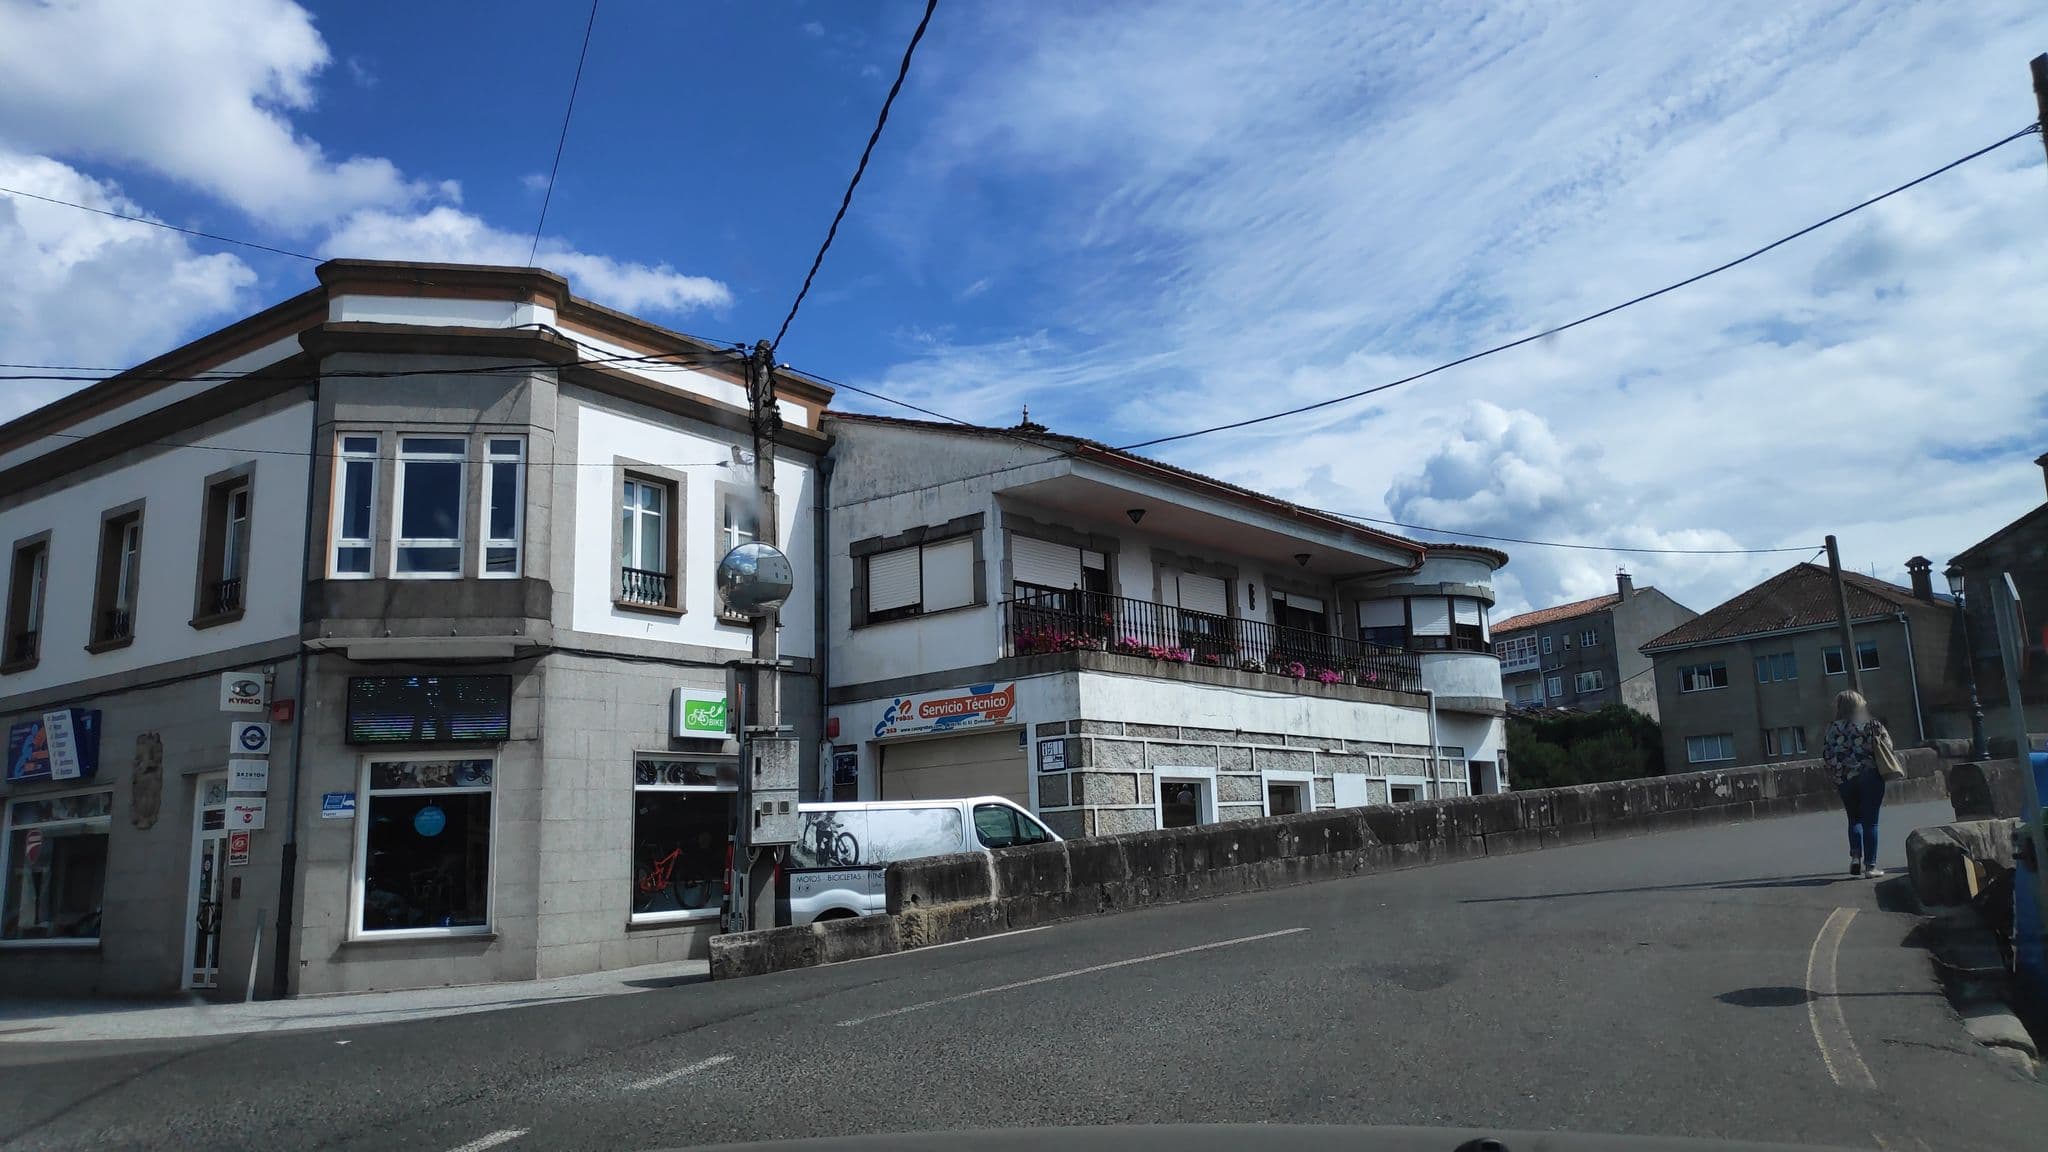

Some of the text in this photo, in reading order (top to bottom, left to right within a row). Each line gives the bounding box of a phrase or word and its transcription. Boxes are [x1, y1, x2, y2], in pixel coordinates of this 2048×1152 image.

[922, 696, 1006, 716] Servicio Técnico
[709, 719, 724, 727] BIKE
[796, 874, 821, 883] MOTOS
